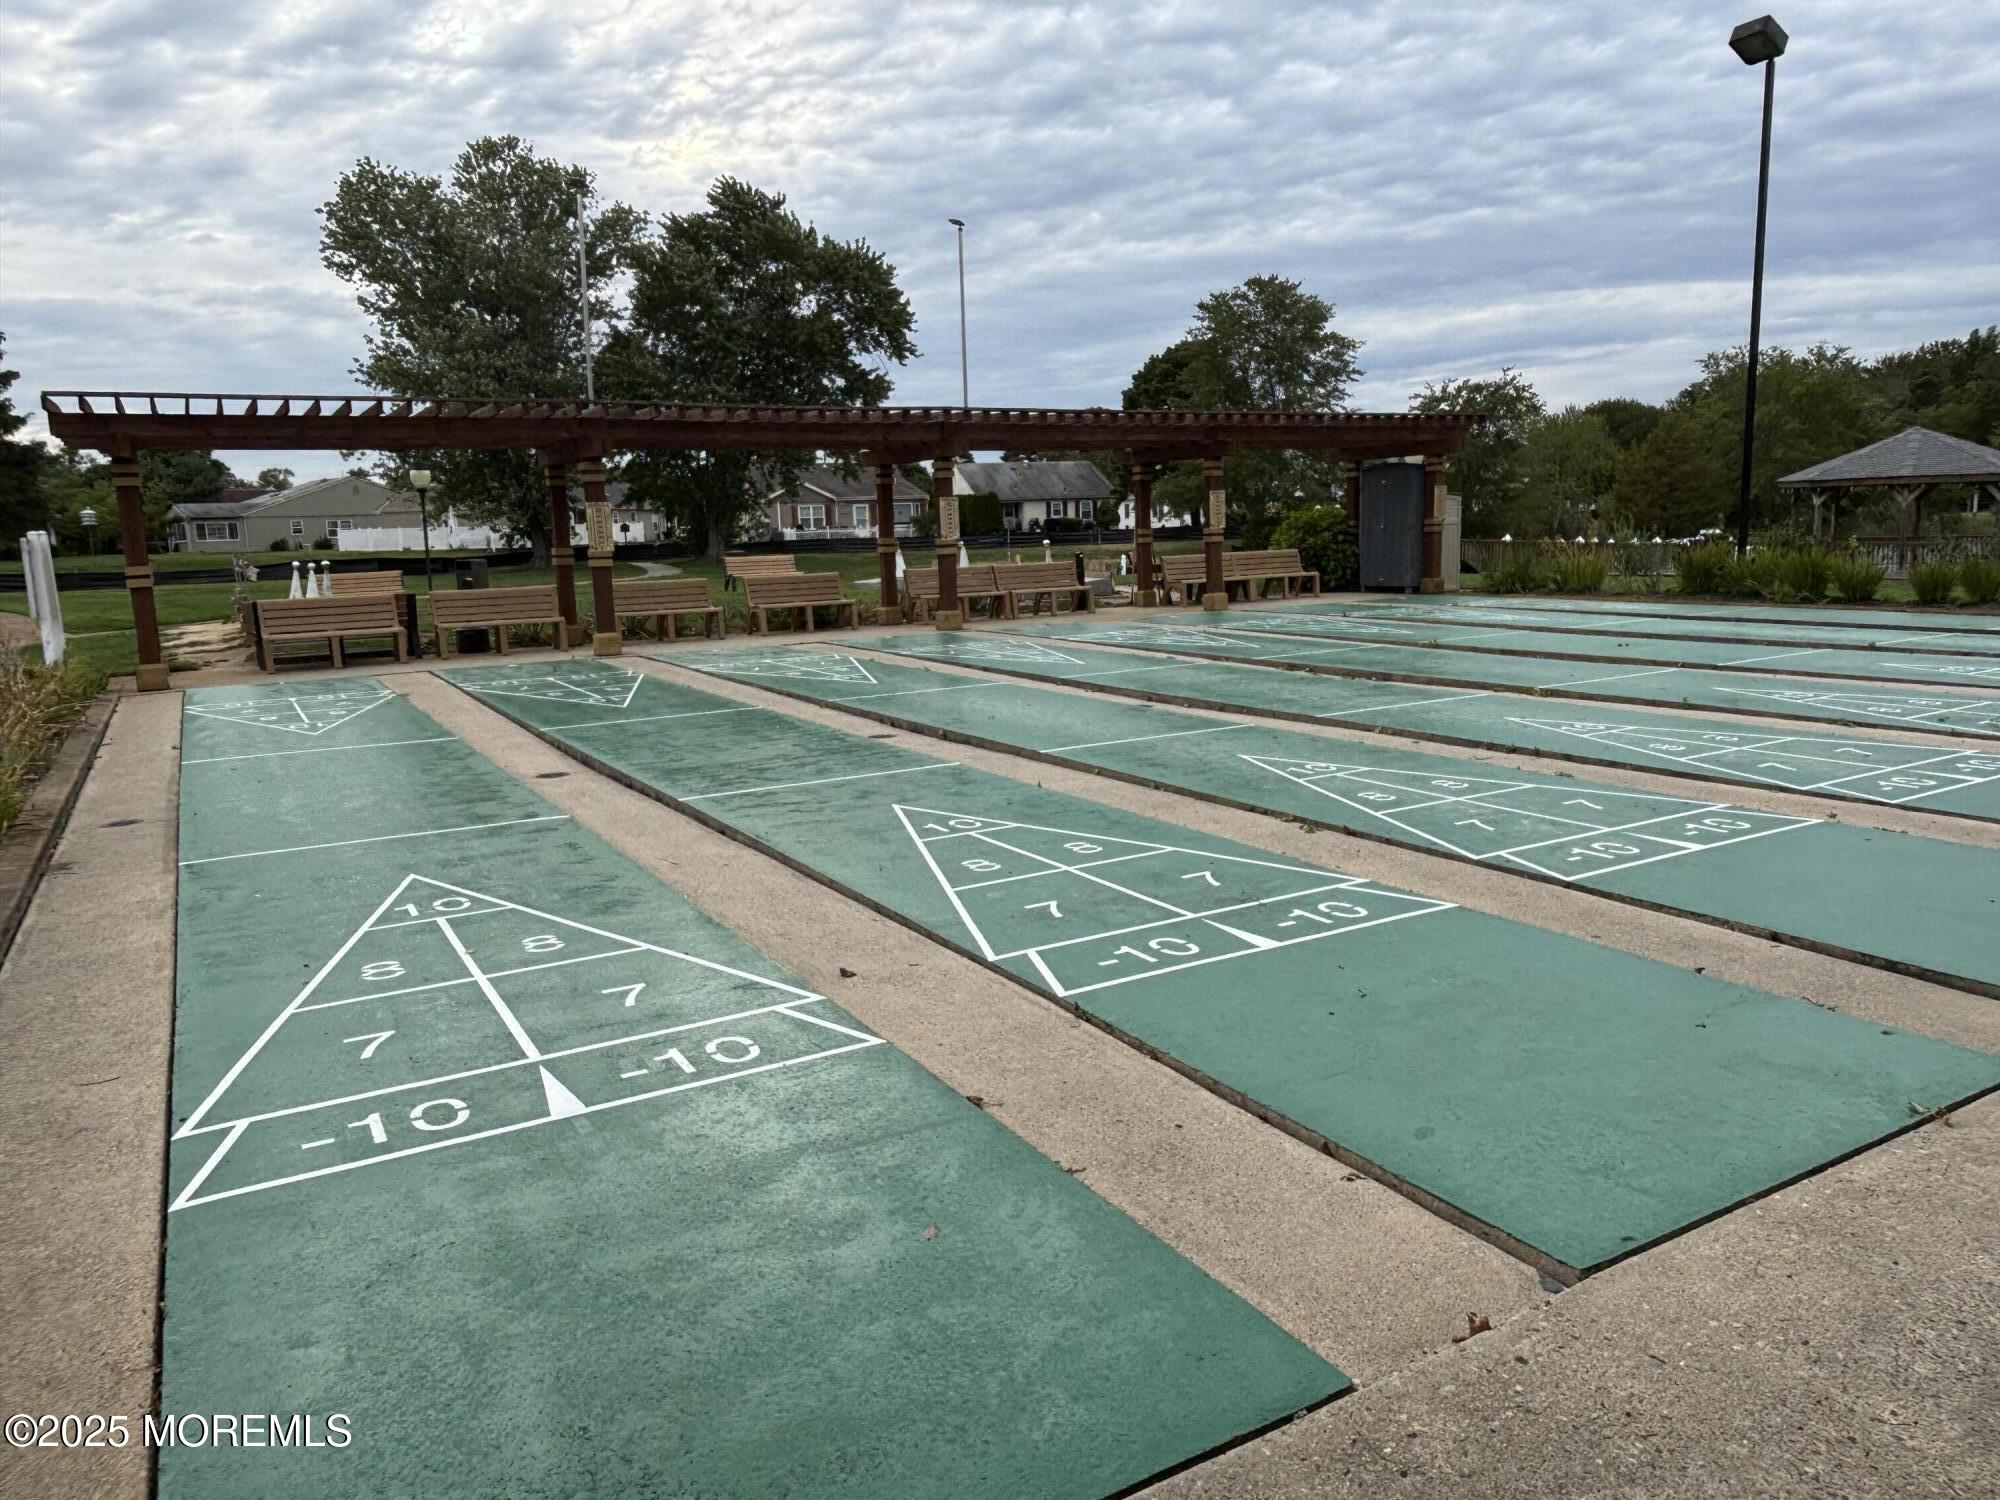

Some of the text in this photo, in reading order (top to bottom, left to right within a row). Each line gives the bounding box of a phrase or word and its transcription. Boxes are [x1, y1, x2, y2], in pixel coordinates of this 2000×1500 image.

[923, 819, 982, 834] 10
[1063, 840, 1103, 854] 8
[960, 859, 1001, 872] 8
[1181, 871, 1222, 887] 7
[394, 897, 472, 917] 10
[1024, 901, 1064, 918] 7
[1277, 901, 1368, 928] -10
[522, 935, 566, 952] 8
[1097, 937, 1200, 967] -10
[361, 961, 405, 981] 8
[601, 983, 646, 1008] 7
[343, 1031, 395, 1060] 7
[620, 1037, 761, 1079] -10
[301, 1098, 471, 1149] -10
